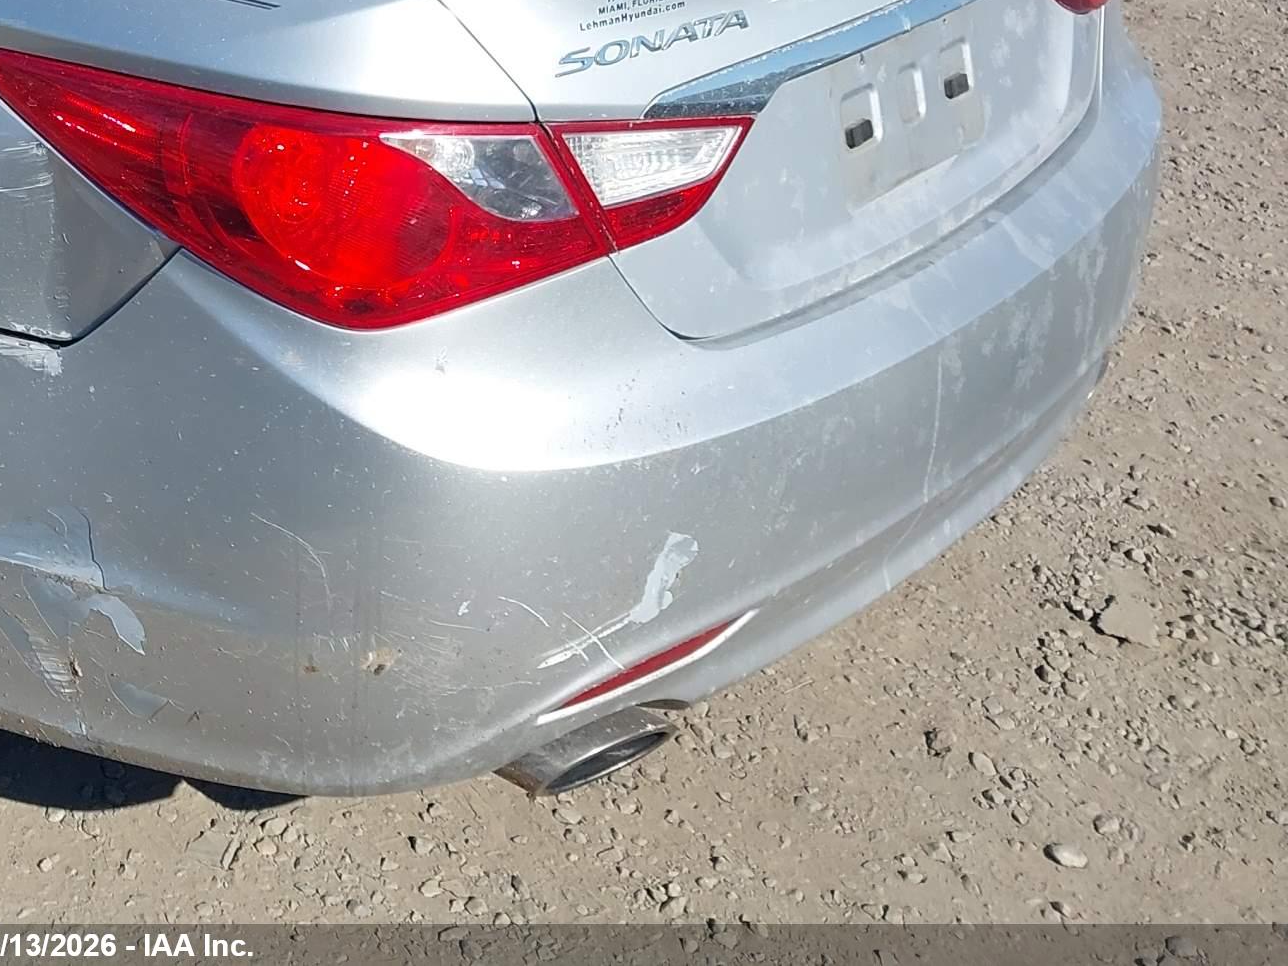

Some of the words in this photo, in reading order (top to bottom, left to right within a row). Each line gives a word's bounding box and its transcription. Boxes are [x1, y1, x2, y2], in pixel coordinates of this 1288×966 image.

[579, 0, 686, 31] LehmanHyundai.com
[598, 4, 631, 15] MIAMI,
[555, 9, 749, 78] SONATA
